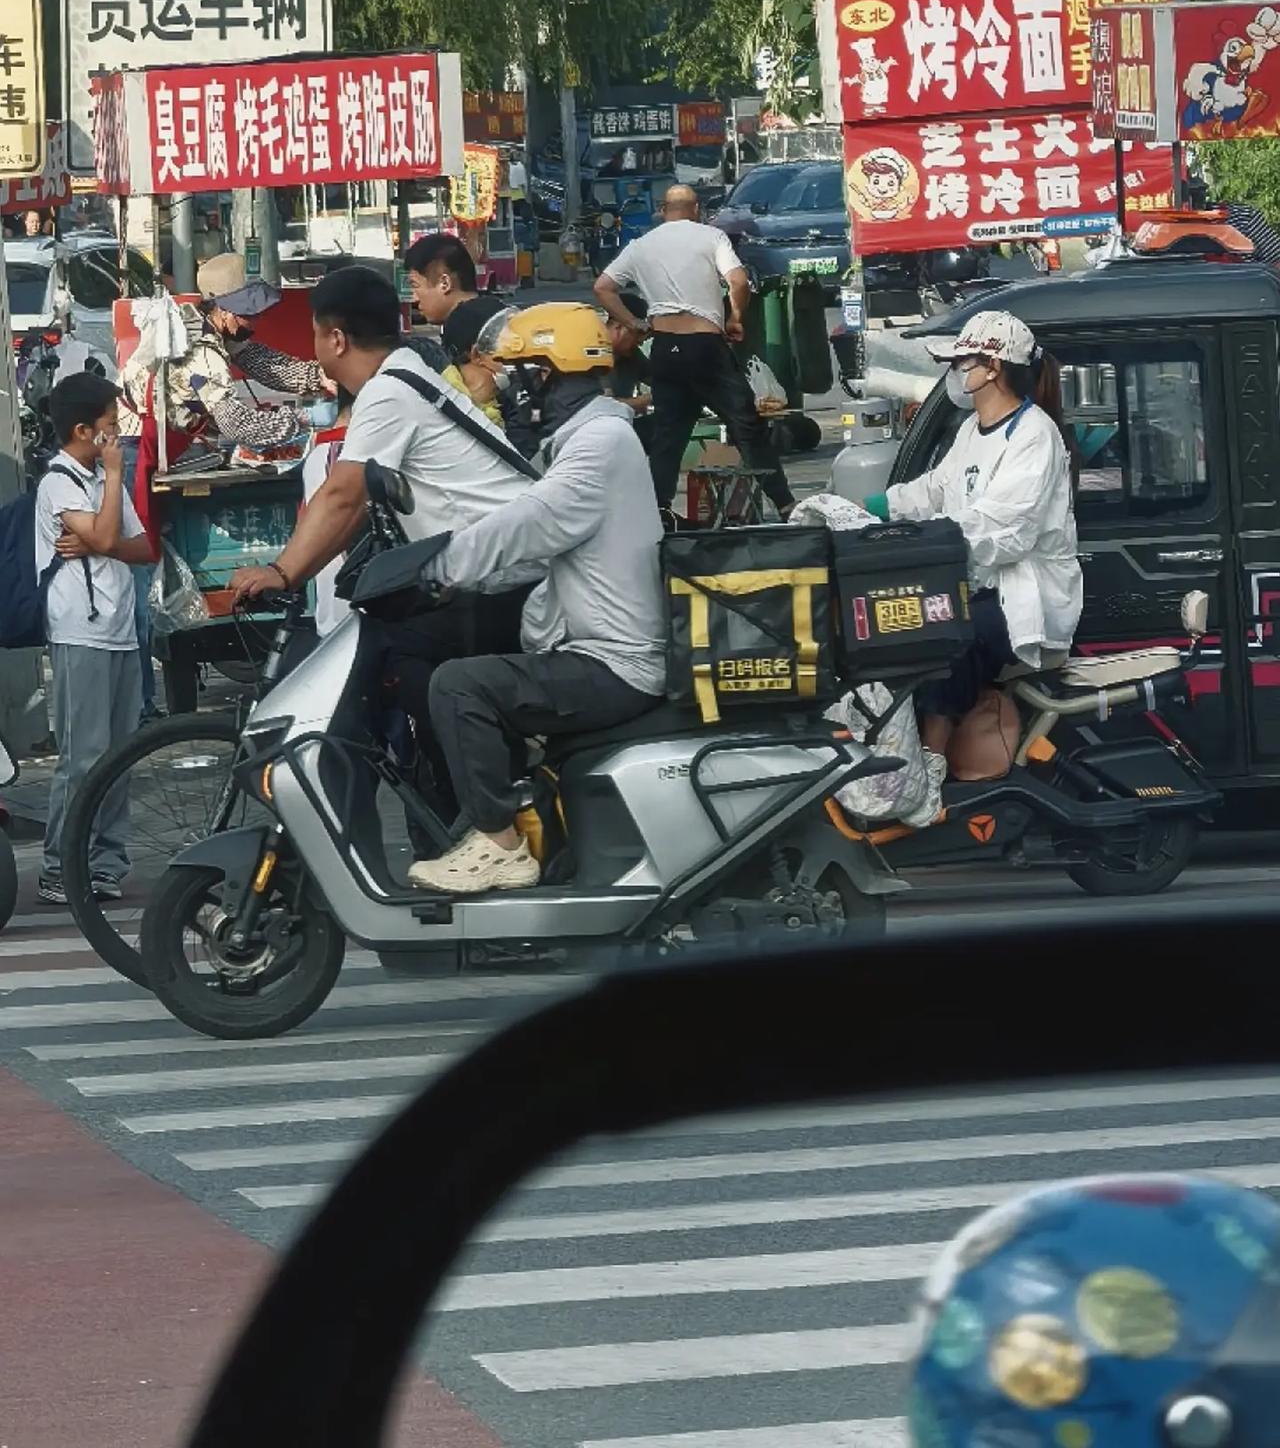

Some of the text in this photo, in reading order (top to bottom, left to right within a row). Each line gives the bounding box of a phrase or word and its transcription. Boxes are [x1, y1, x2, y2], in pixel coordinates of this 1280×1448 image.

[154, 79, 229, 185] 臭豆腐
[234, 73, 333, 179] 烤毛鸡蛋
[337, 66, 438, 172] 烤脆皮肠
[918, 114, 1118, 169] 芝士火
[925, 164, 1081, 221] 烤冷面
[718, 658, 791, 678] 扫码报名
